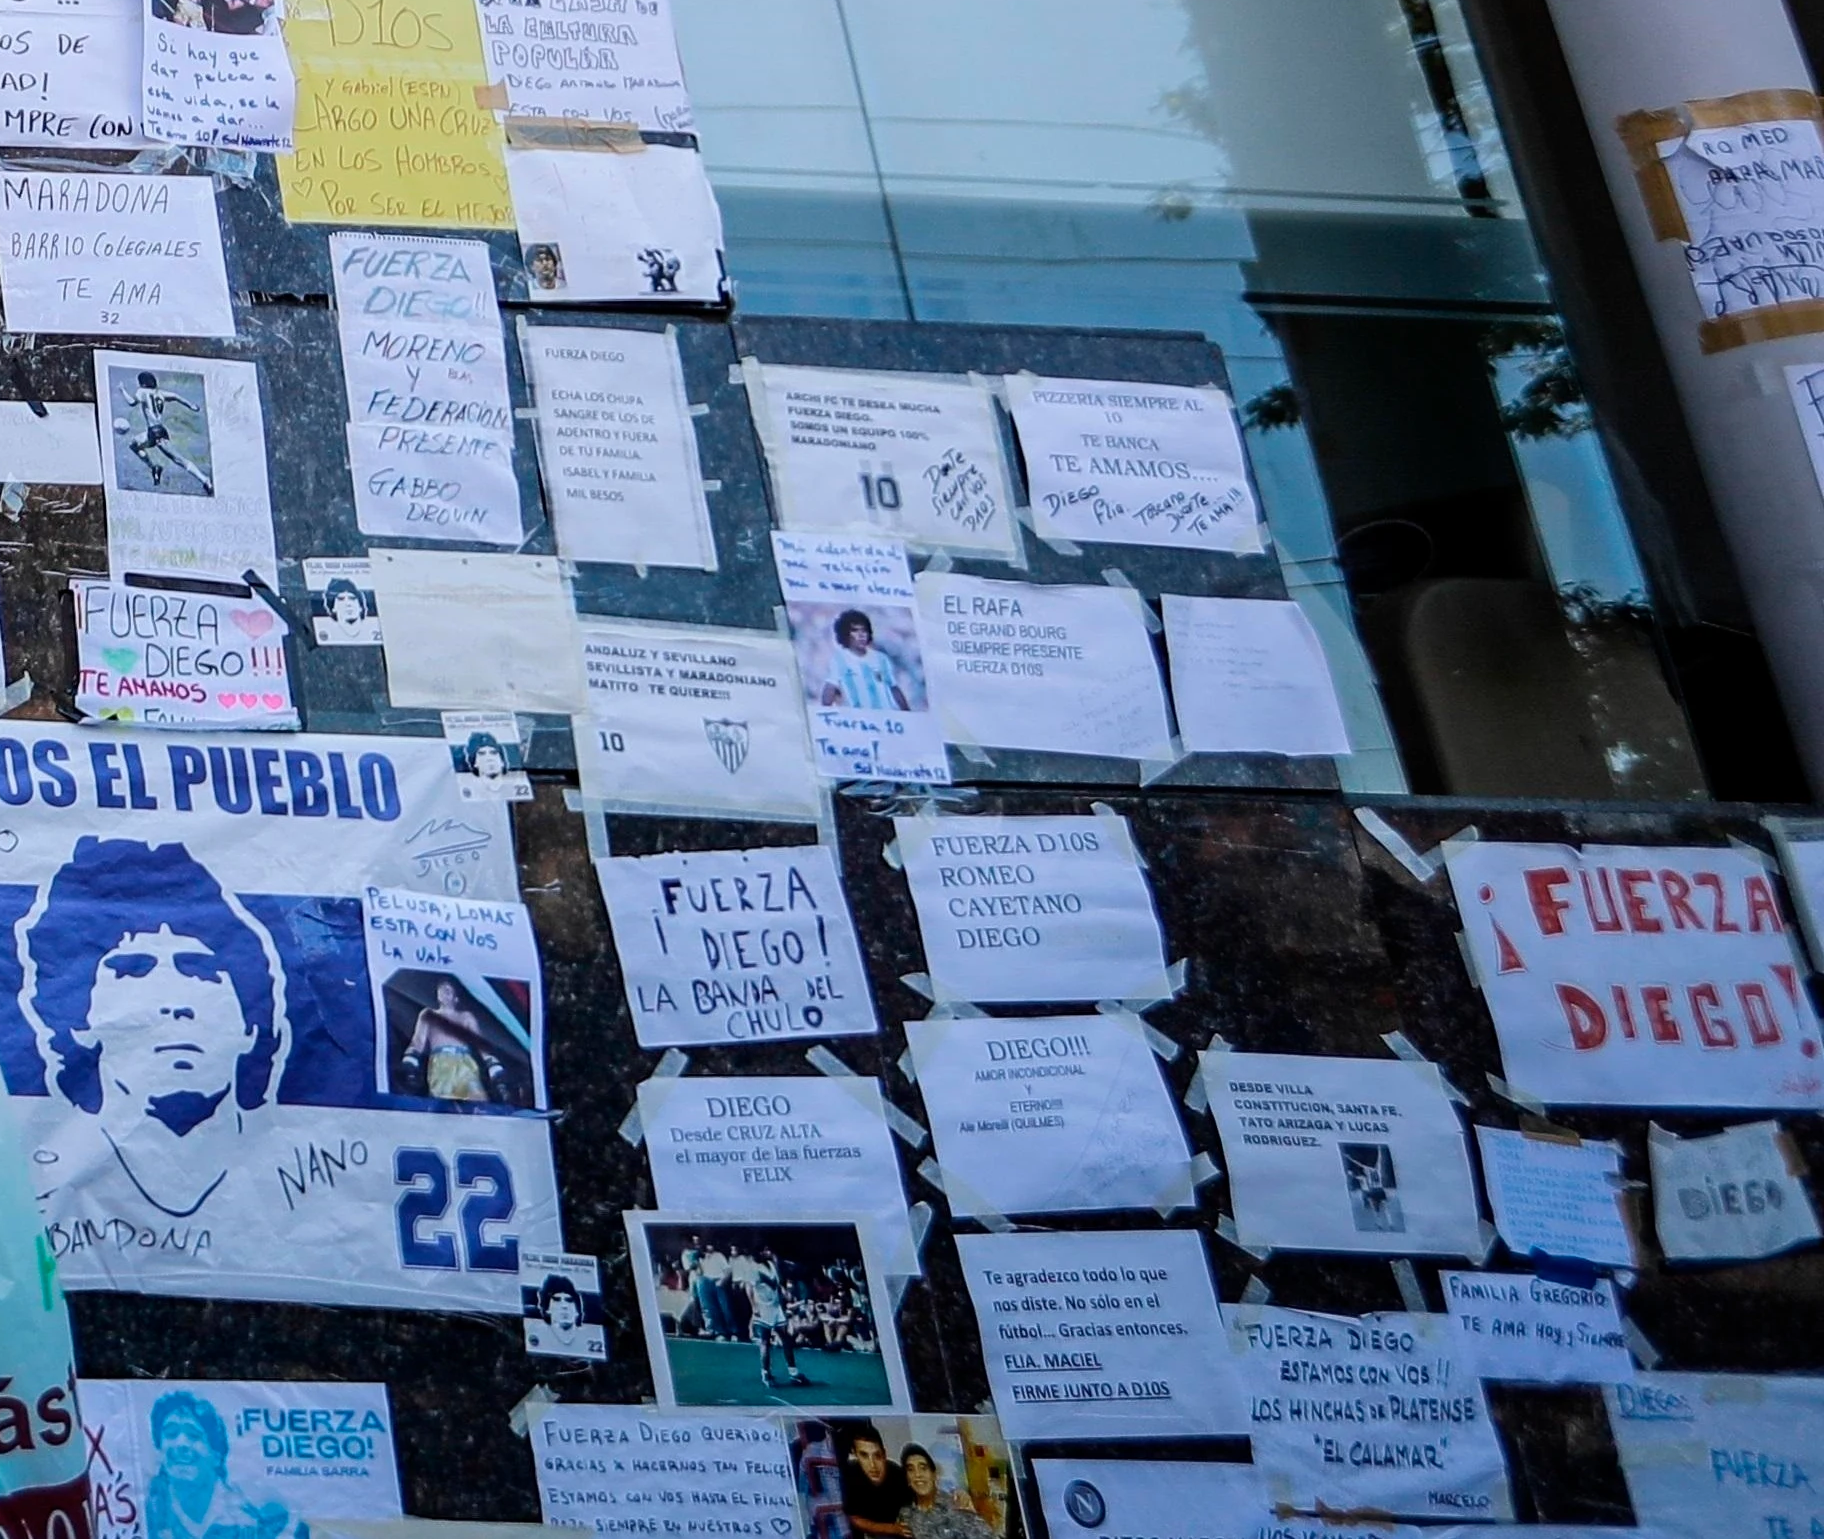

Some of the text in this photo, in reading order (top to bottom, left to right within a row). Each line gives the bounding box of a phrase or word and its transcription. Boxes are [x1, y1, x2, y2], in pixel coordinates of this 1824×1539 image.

[57, 31, 92, 56] DE
[3, 178, 170, 215] MARADONA
[10, 232, 85, 260] BARRIO
[56, 278, 161, 306] TE AMA
[1107, 393, 1179, 411] SIEMPRE
[1184, 396, 1203, 412] AL
[1050, 453, 1083, 474] TE
[943, 595, 1022, 618] EL RAFA
[947, 621, 1067, 641] DE GRAND BOURG
[584, 643, 642, 660] ANDALUZ
[647, 649, 657, 662] Y
[951, 639, 1083, 661] SIEMPRE PRESENTE
[87, 742, 158, 811] EL
[170, 744, 401, 822] PUEBLO
[930, 831, 1099, 858] FUERZA D10S
[938, 864, 1035, 888] ROMEO
[948, 893, 1083, 917] CAYETANO
[956, 926, 1041, 950] DIEGO
[1229, 1080, 1313, 1098] DESDE VILLA
[705, 1094, 791, 1119] DIEGO
[670, 1122, 821, 1144] Desde CRUZ ALTA
[742, 1166, 793, 1184] FELIX
[391, 1144, 520, 1275] 22
[983, 1266, 1168, 1289] Te agradezco todo lo que
[1044, 1351, 1102, 1370] MACIEL
[262, 1433, 376, 1462] DIEGO!
